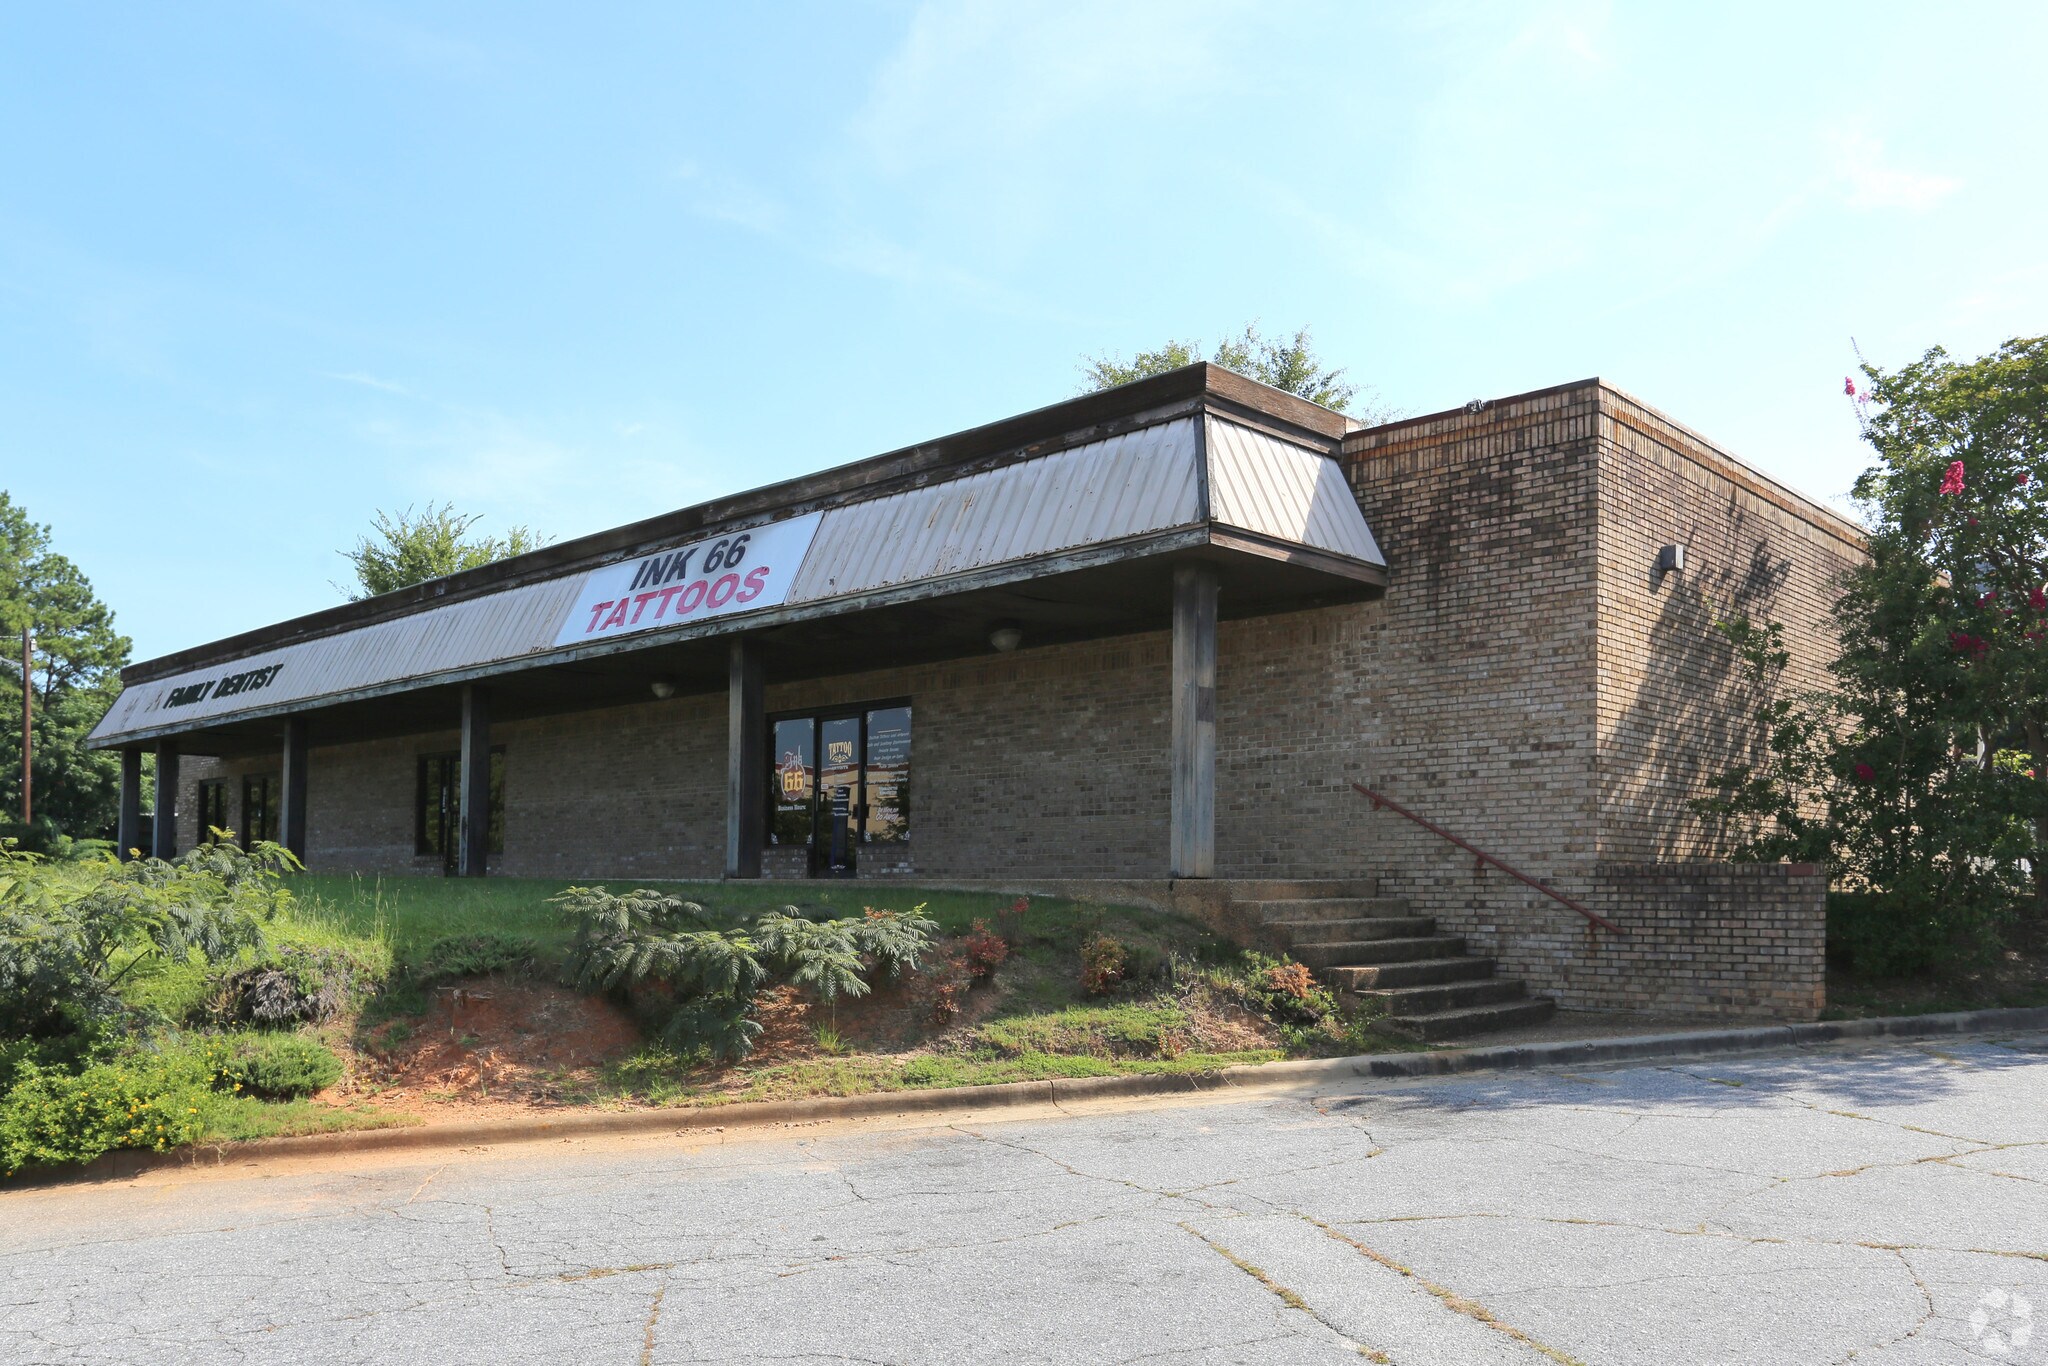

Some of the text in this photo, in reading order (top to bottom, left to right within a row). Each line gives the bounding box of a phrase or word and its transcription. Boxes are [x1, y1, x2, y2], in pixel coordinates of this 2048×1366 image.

[628, 534, 750, 591] INK 66
[585, 566, 770, 633] TATTOOS
[163, 664, 284, 709] FAMILY DENTIST
[828, 741, 852, 760] TATTOO
[784, 771, 803, 792] 66
